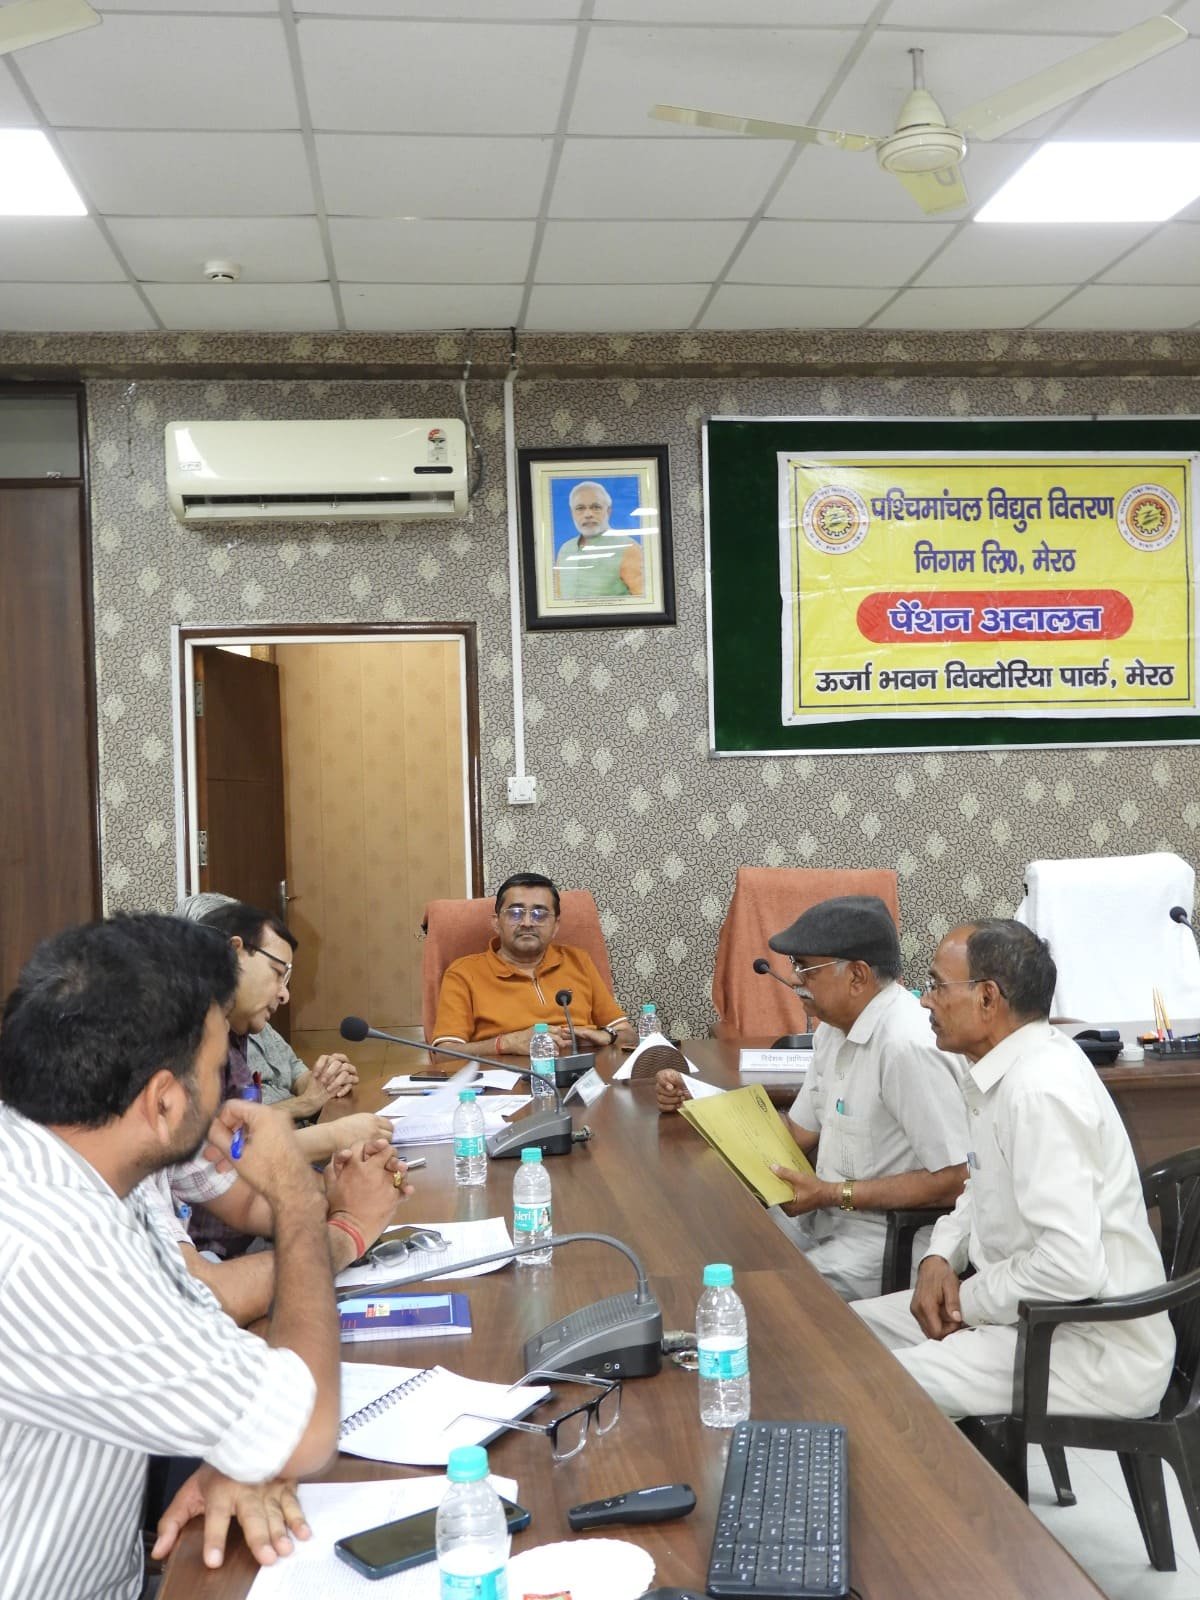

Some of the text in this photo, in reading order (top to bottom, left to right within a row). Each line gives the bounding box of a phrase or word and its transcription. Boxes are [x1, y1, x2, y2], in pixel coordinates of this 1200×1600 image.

[871, 487, 983, 521] पश्चिमांचल
[987, 487, 1042, 533] विद्युत
[1048, 487, 1115, 520] वितरण
[914, 540, 976, 573] निगम
[1032, 540, 1077, 573] मेरठ
[888, 600, 1103, 634] पेंशन अदालत
[815, 659, 1175, 692] ऊर्जा भवन विक्टोरिया पार्क, मेरठ
